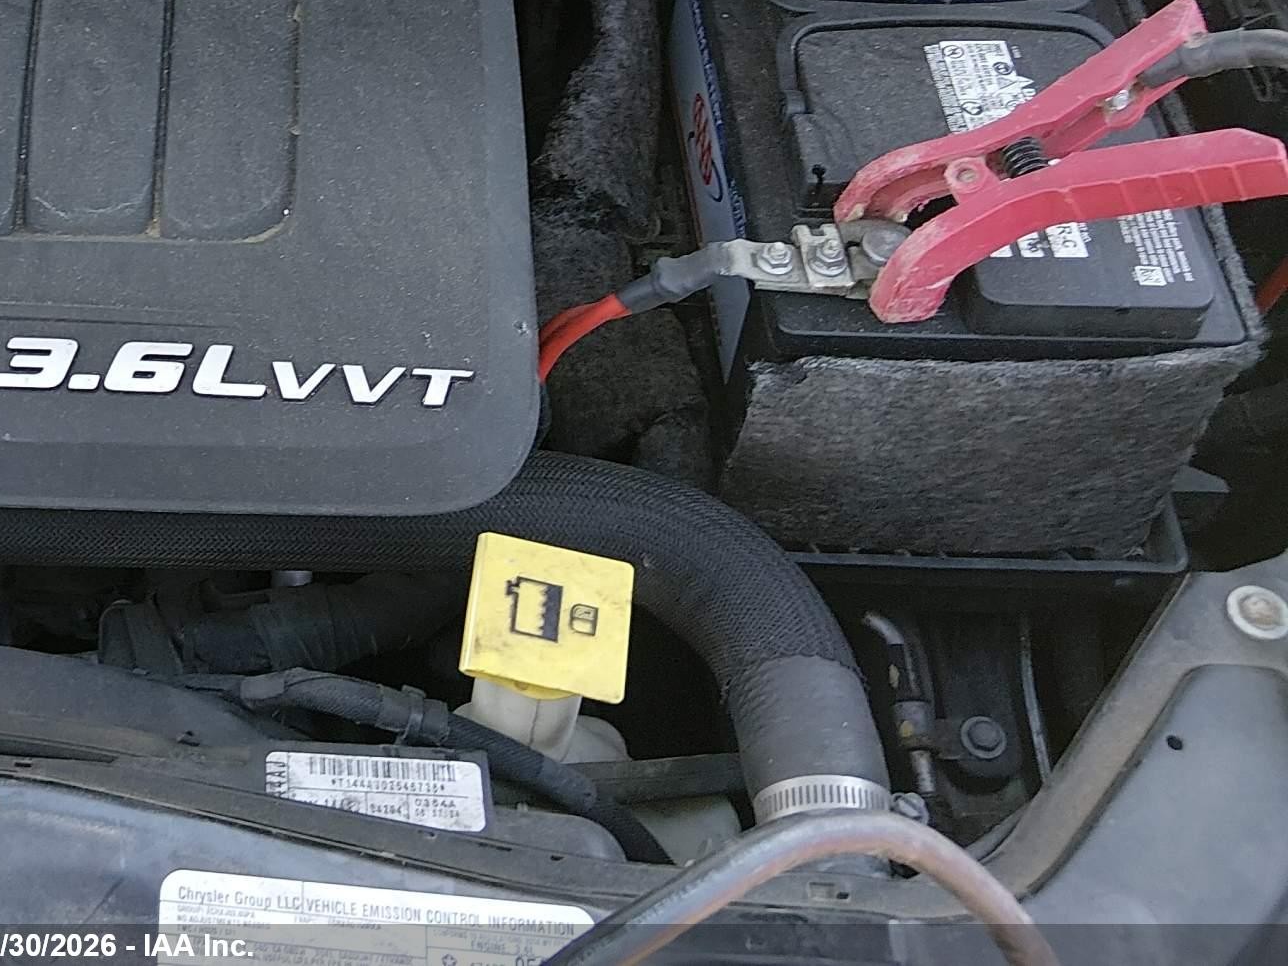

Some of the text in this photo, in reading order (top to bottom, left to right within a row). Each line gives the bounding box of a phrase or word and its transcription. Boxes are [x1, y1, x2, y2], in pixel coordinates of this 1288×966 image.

[271, 360, 475, 406] VVT
[178, 886, 302, 911] Chrysler Group LLC
[304, 898, 575, 936] VEHICLE EMISSION CONTROL INFORMATION
